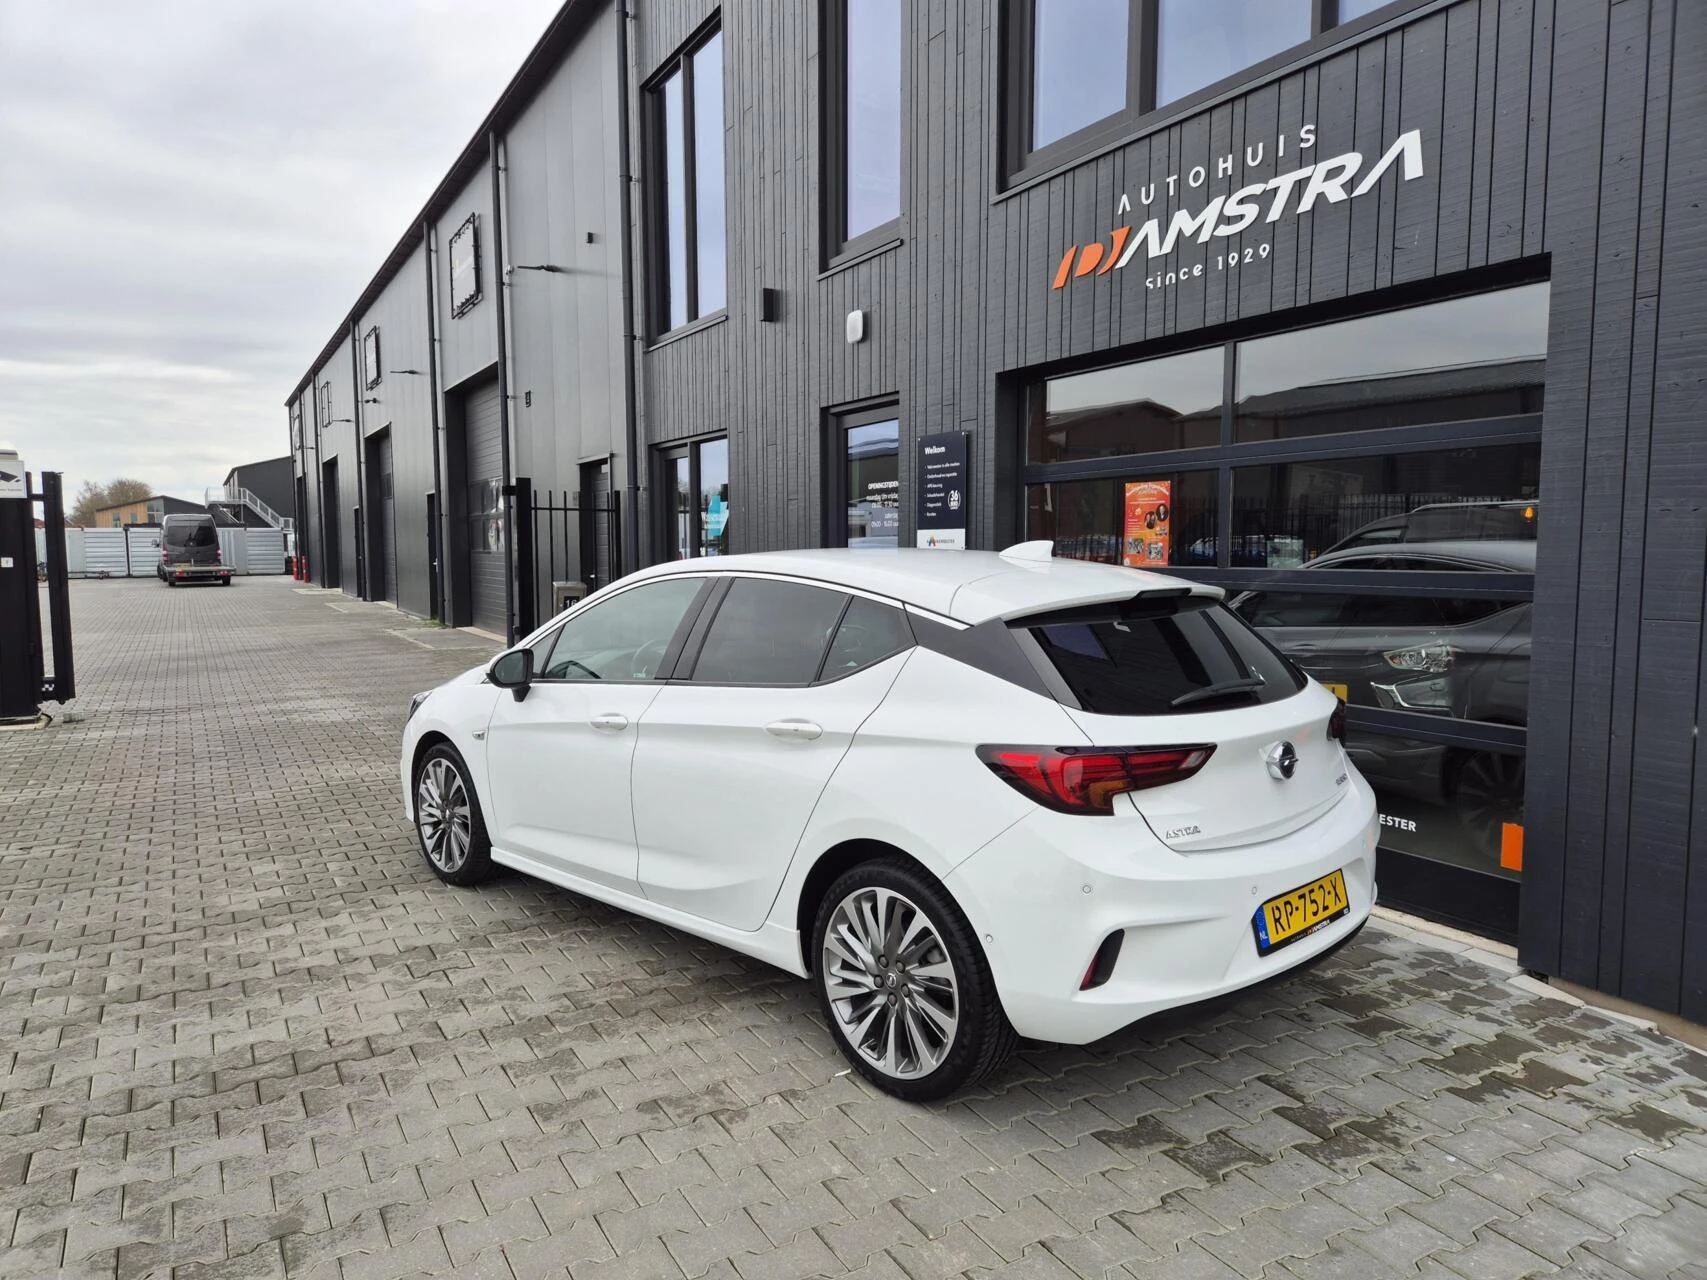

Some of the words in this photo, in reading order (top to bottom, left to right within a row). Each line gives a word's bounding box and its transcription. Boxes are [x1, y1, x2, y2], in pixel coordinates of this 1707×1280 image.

[1117, 124, 1316, 215] AUTOHUIS
[1145, 263, 1204, 290] since
[1216, 243, 1271, 271] 1929
[925, 446, 945, 455] Welkom
[1271, 876, 1342, 935] RP-752-X
[1259, 931, 1268, 941] NL
